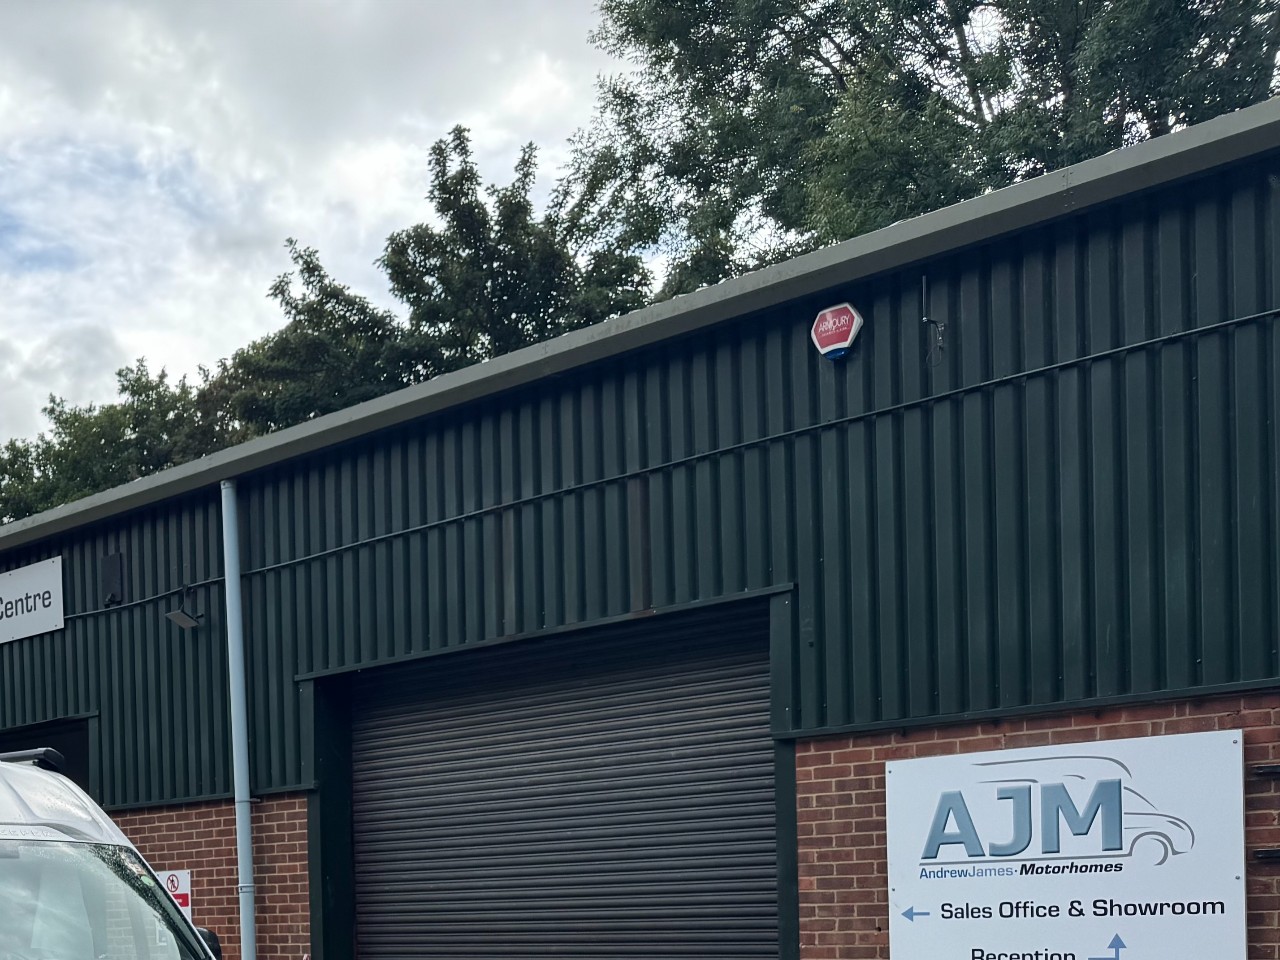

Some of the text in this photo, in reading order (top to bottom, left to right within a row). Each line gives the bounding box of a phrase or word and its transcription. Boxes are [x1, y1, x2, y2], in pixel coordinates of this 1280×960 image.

[920, 778, 1124, 860] AJM
[1019, 862, 1124, 876] Motorhomes
[940, 898, 1226, 919] Sales Office & Showroom
